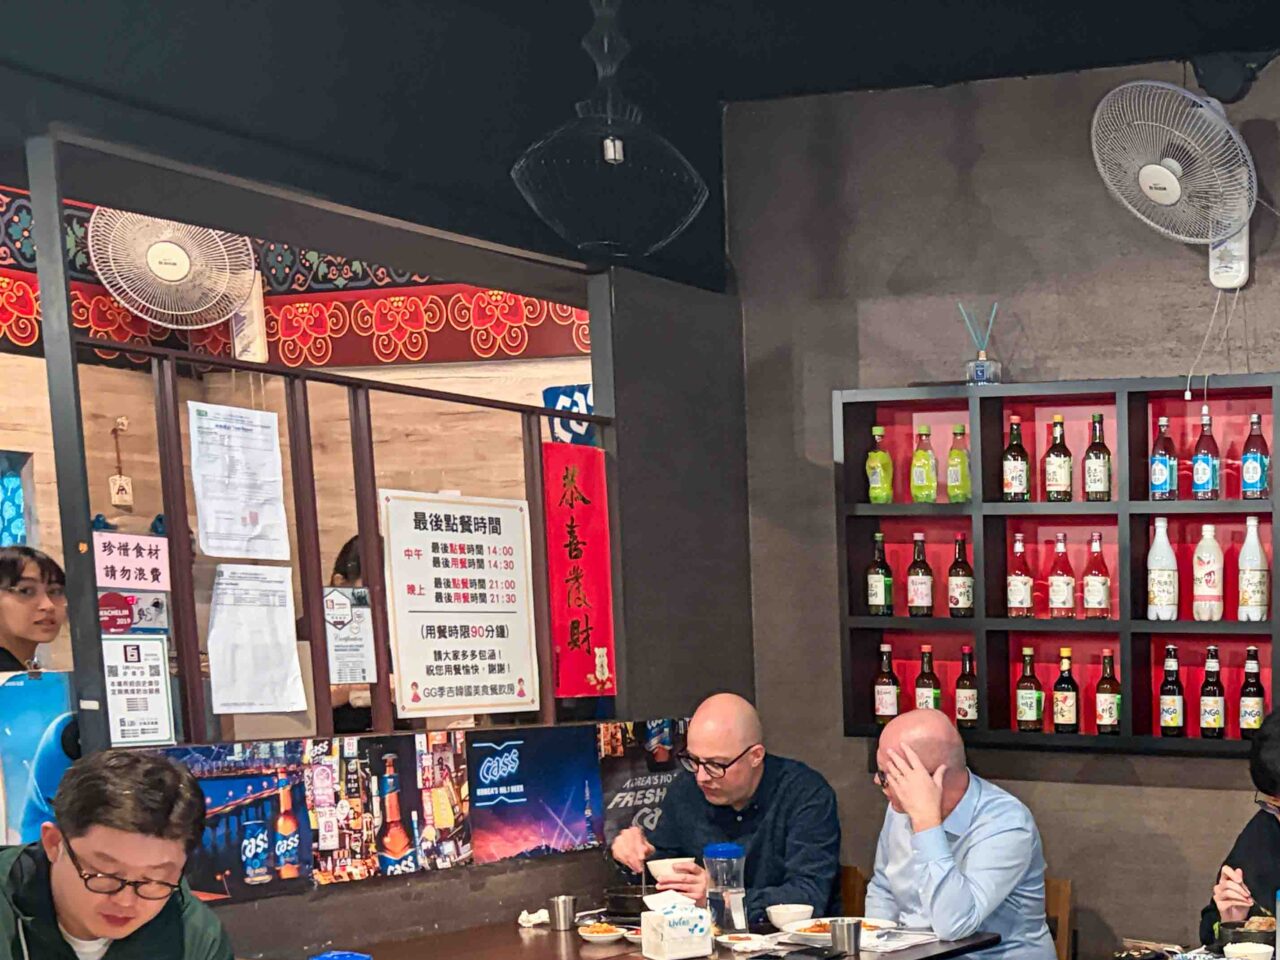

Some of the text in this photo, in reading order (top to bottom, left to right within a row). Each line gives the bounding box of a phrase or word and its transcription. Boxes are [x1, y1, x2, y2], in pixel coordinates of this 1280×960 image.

[413, 511, 502, 537] 最後點餐時間
[101, 541, 161, 560] 珍惜食材
[403, 547, 424, 561] 中午
[431, 541, 514, 557] 最後點餐時間 14:00
[432, 556, 515, 571] 最後用餐時間 14:30
[103, 565, 162, 584] 請勿浪費
[406, 583, 426, 598] 晚上
[434, 576, 516, 591] 最後點餐時間 21:00
[434, 590, 517, 605] 最後用餐時間 21:30
[479, 749, 520, 784] Cass
[607, 787, 668, 810] FRESH
[275, 833, 300, 856] Cass
